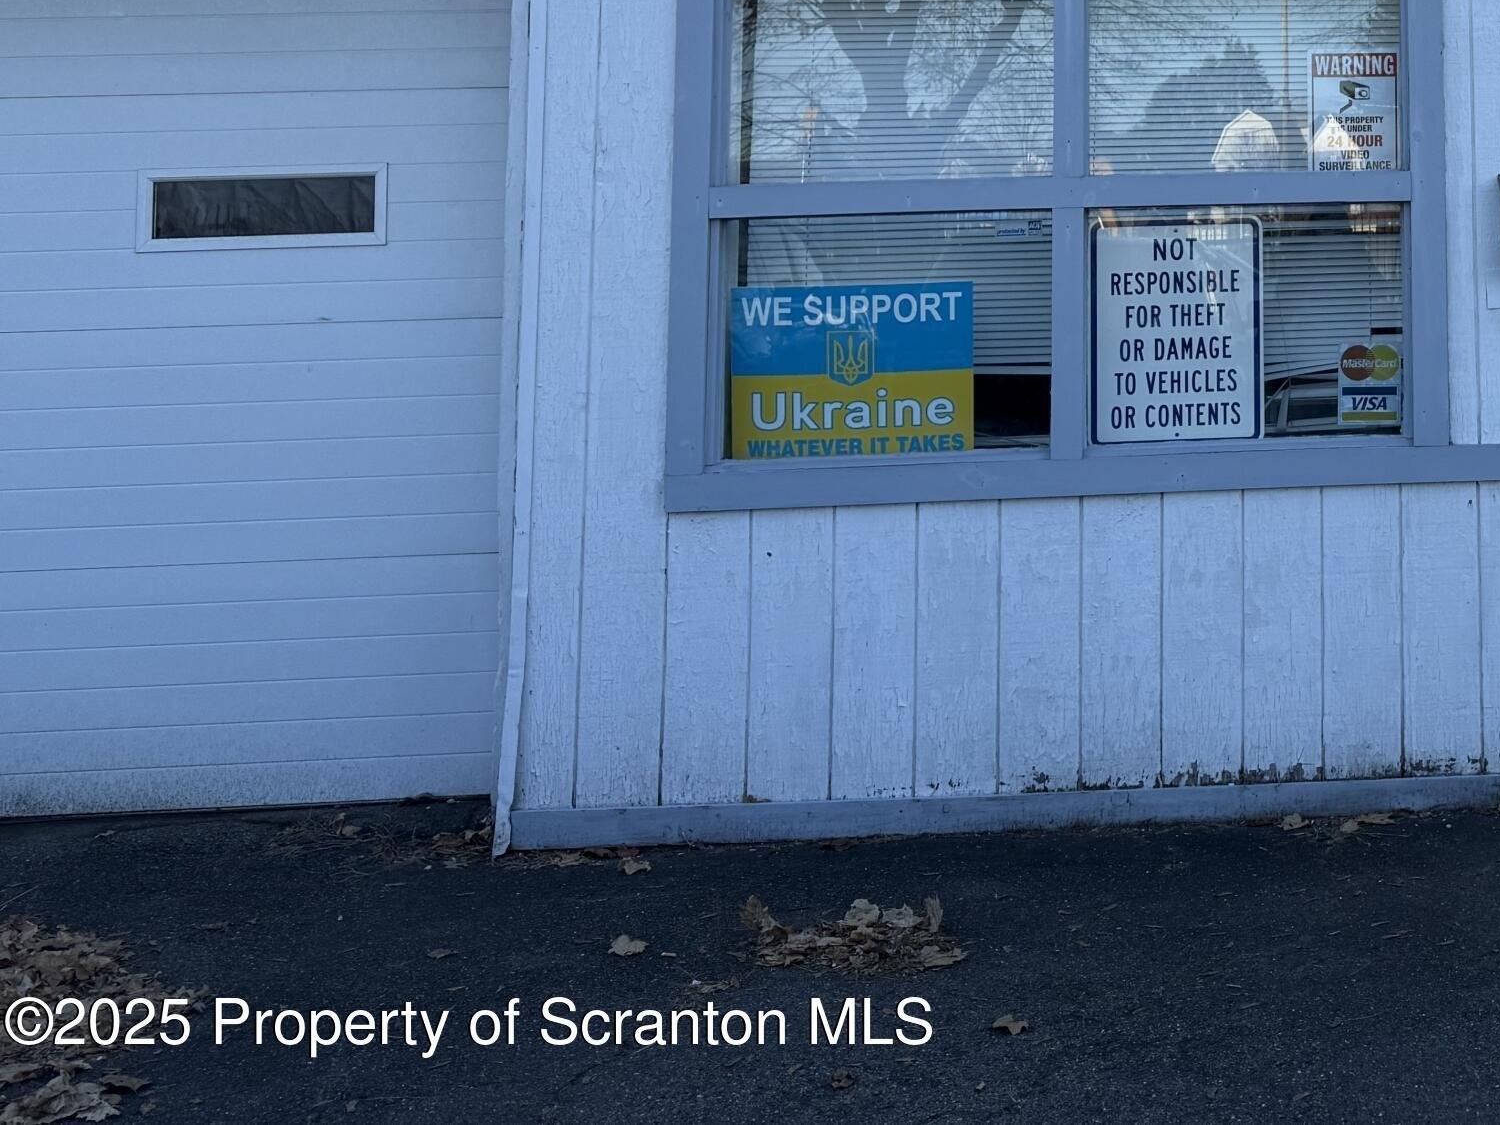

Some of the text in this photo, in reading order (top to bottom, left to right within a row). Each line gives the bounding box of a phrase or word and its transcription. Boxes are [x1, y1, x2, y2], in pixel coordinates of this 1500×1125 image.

[1314, 54, 1395, 76] WARNING
[1345, 116, 1384, 124] PROPERTY
[1347, 124, 1373, 132] UNDER
[1327, 135, 1343, 148] 24
[1319, 160, 1391, 172] SURVEILLANCE
[1341, 149, 1370, 160] VIDEO
[1152, 237, 1198, 262] NOT
[1110, 270, 1241, 296] RESPONSIBLE
[741, 291, 963, 327] WE SUPPORT
[1125, 302, 1226, 329] FOR THEFT
[1119, 335, 1232, 362] OR DAMAGE
[1342, 358, 1396, 368] MasterCard
[1114, 368, 1238, 396] TO VEHICLES
[751, 387, 955, 432] Ukraine
[1111, 401, 1241, 429] OR CONTENTS
[1351, 396, 1388, 411] VISA
[747, 433, 965, 458] WHATEVER IT TAKES
